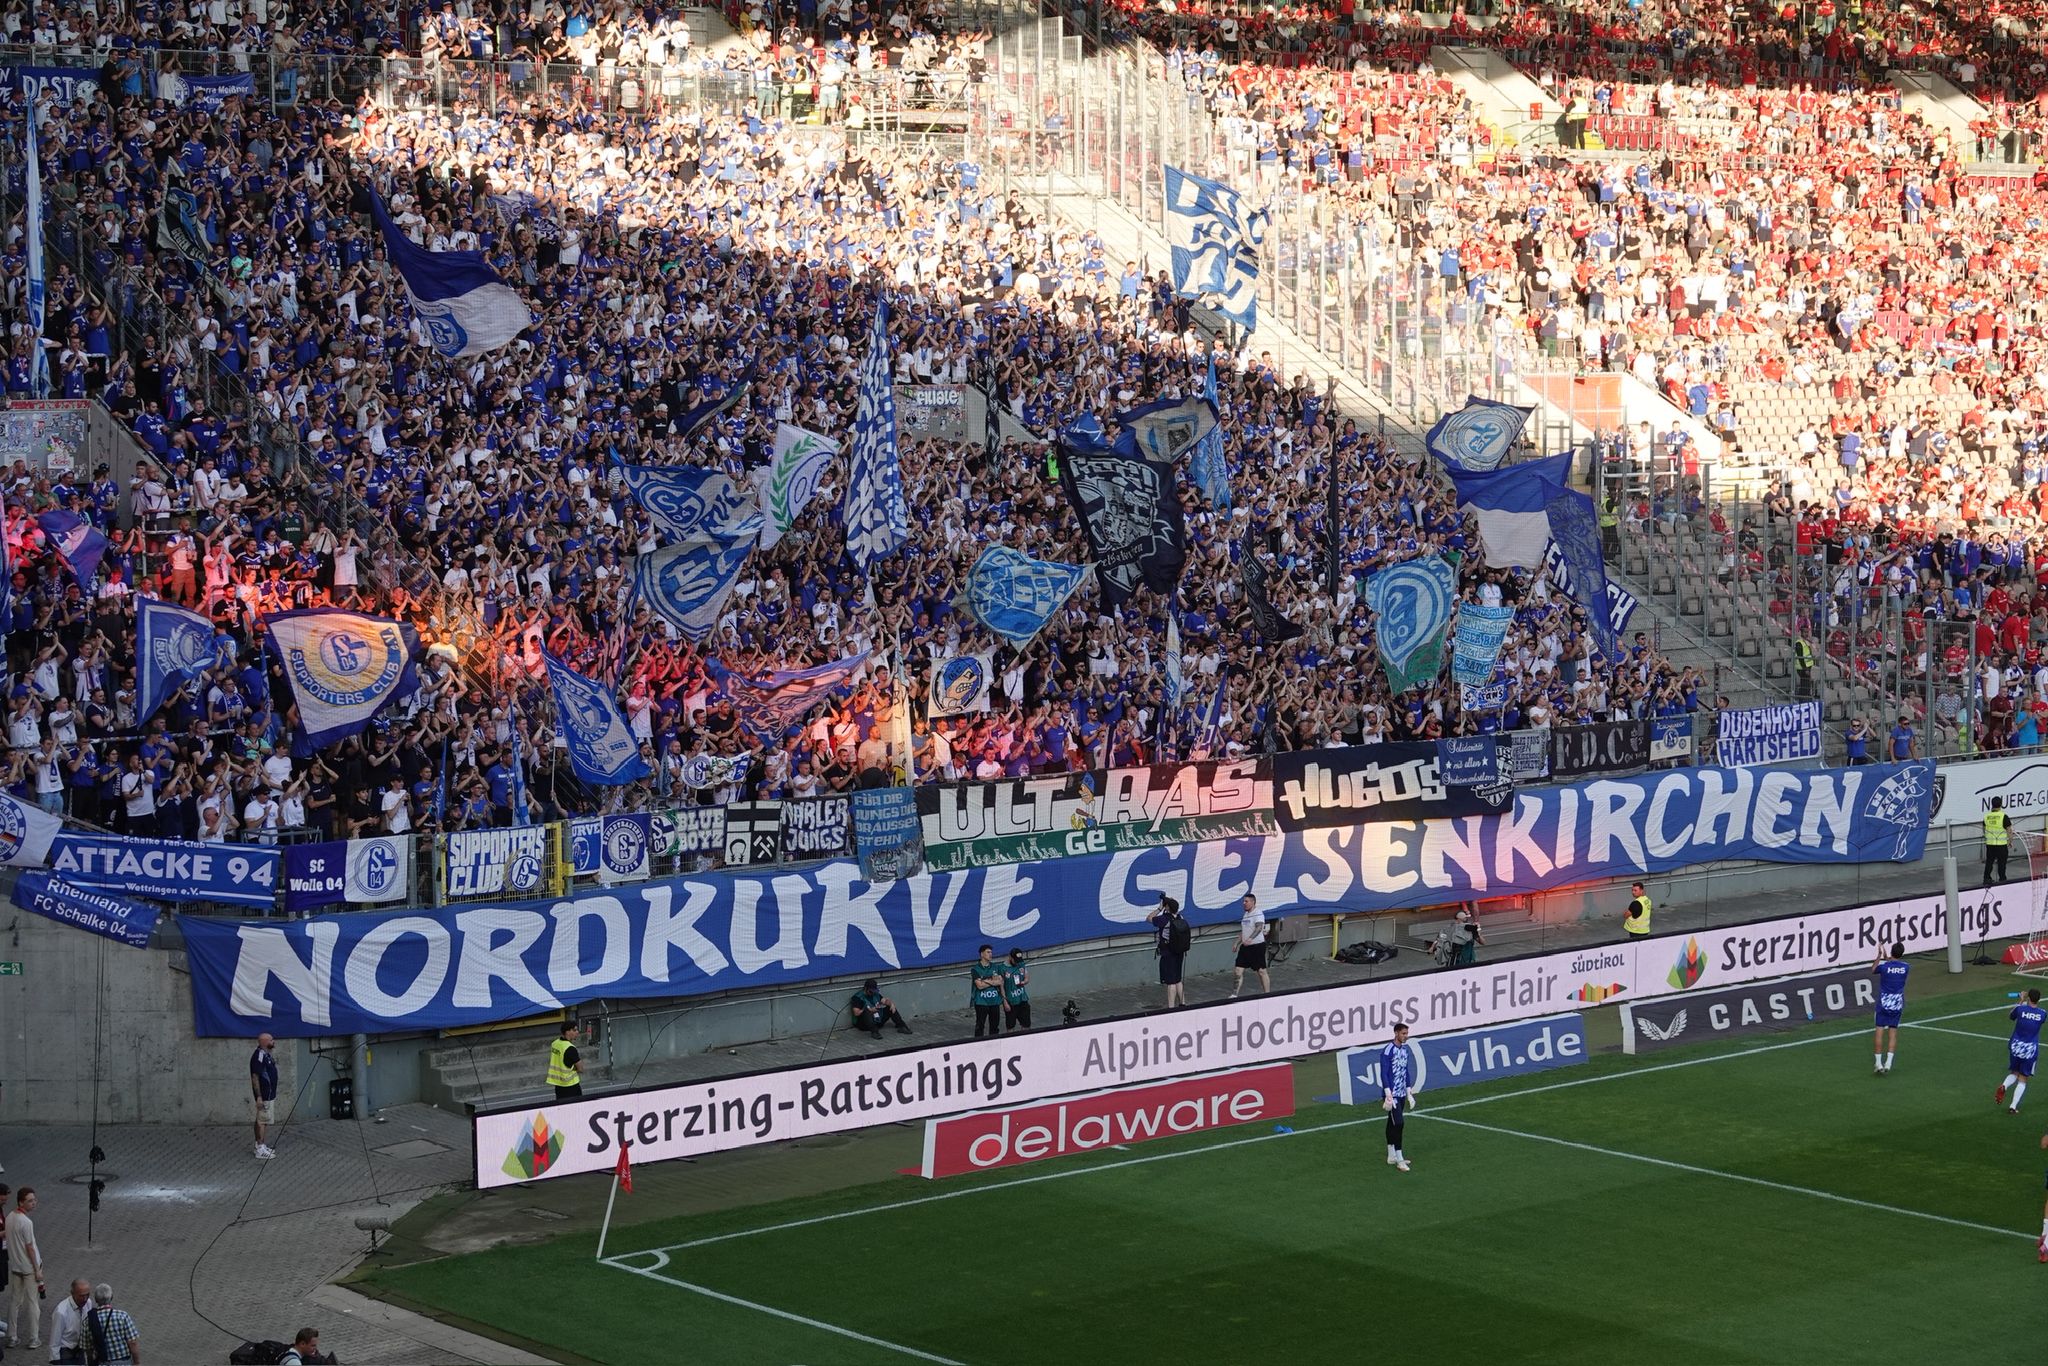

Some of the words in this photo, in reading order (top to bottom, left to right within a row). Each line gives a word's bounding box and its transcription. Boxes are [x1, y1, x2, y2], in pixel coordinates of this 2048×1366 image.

[291, 651, 365, 705] SUPPORTERS
[372, 662, 399, 694] CLUB
[1719, 702, 1819, 738] DUDENHOFEN
[854, 792, 881, 806] FÜR
[883, 792, 903, 805] DIE
[1280, 756, 1447, 820] HUGOS
[677, 807, 724, 832] BLUE
[855, 807, 899, 821] JUNGS
[900, 802, 918, 817] DIE
[122, 835, 160, 847] Schalke
[572, 823, 601, 837] URVE
[678, 830, 724, 850] BOYZ
[786, 826, 846, 851] JUNGS
[857, 833, 902, 846] STEHN
[450, 825, 546, 867] SUPPORTERS
[54, 843, 213, 882] ATTACKE
[227, 856, 274, 887] 94
[309, 859, 325, 874] SC
[370, 847, 382, 873] S
[125, 882, 178, 896] Wettringen
[180, 885, 200, 897] e.V.
[290, 878, 323, 893] Wolle
[325, 877, 344, 891] 04
[369, 873, 382, 888] 04
[450, 864, 506, 896] CLUB
[229, 862, 1041, 1028] NORDKURVE
[1099, 767, 1863, 924] GELSENKIRCHEN
[33, 893, 53, 912] FC
[55, 901, 108, 931] Schalke
[110, 921, 127, 937] 04
[1720, 898, 2003, 973] Sterzing-Ratschngs
[1887, 966, 1906, 974] HRS
[1709, 979, 1876, 1031] CASTOR
[2021, 1011, 2042, 1021] HRS
[1082, 1027, 1210, 1081] Alpiner
[1221, 996, 1419, 1054] Hochgenuss
[1430, 979, 1481, 1021] mit
[1492, 967, 1558, 1010] Flair
[1440, 1027, 1581, 1076] vlh.de
[586, 1053, 1023, 1154] Sterzing-Ratschings
[967, 1088, 1264, 1170] delaware
